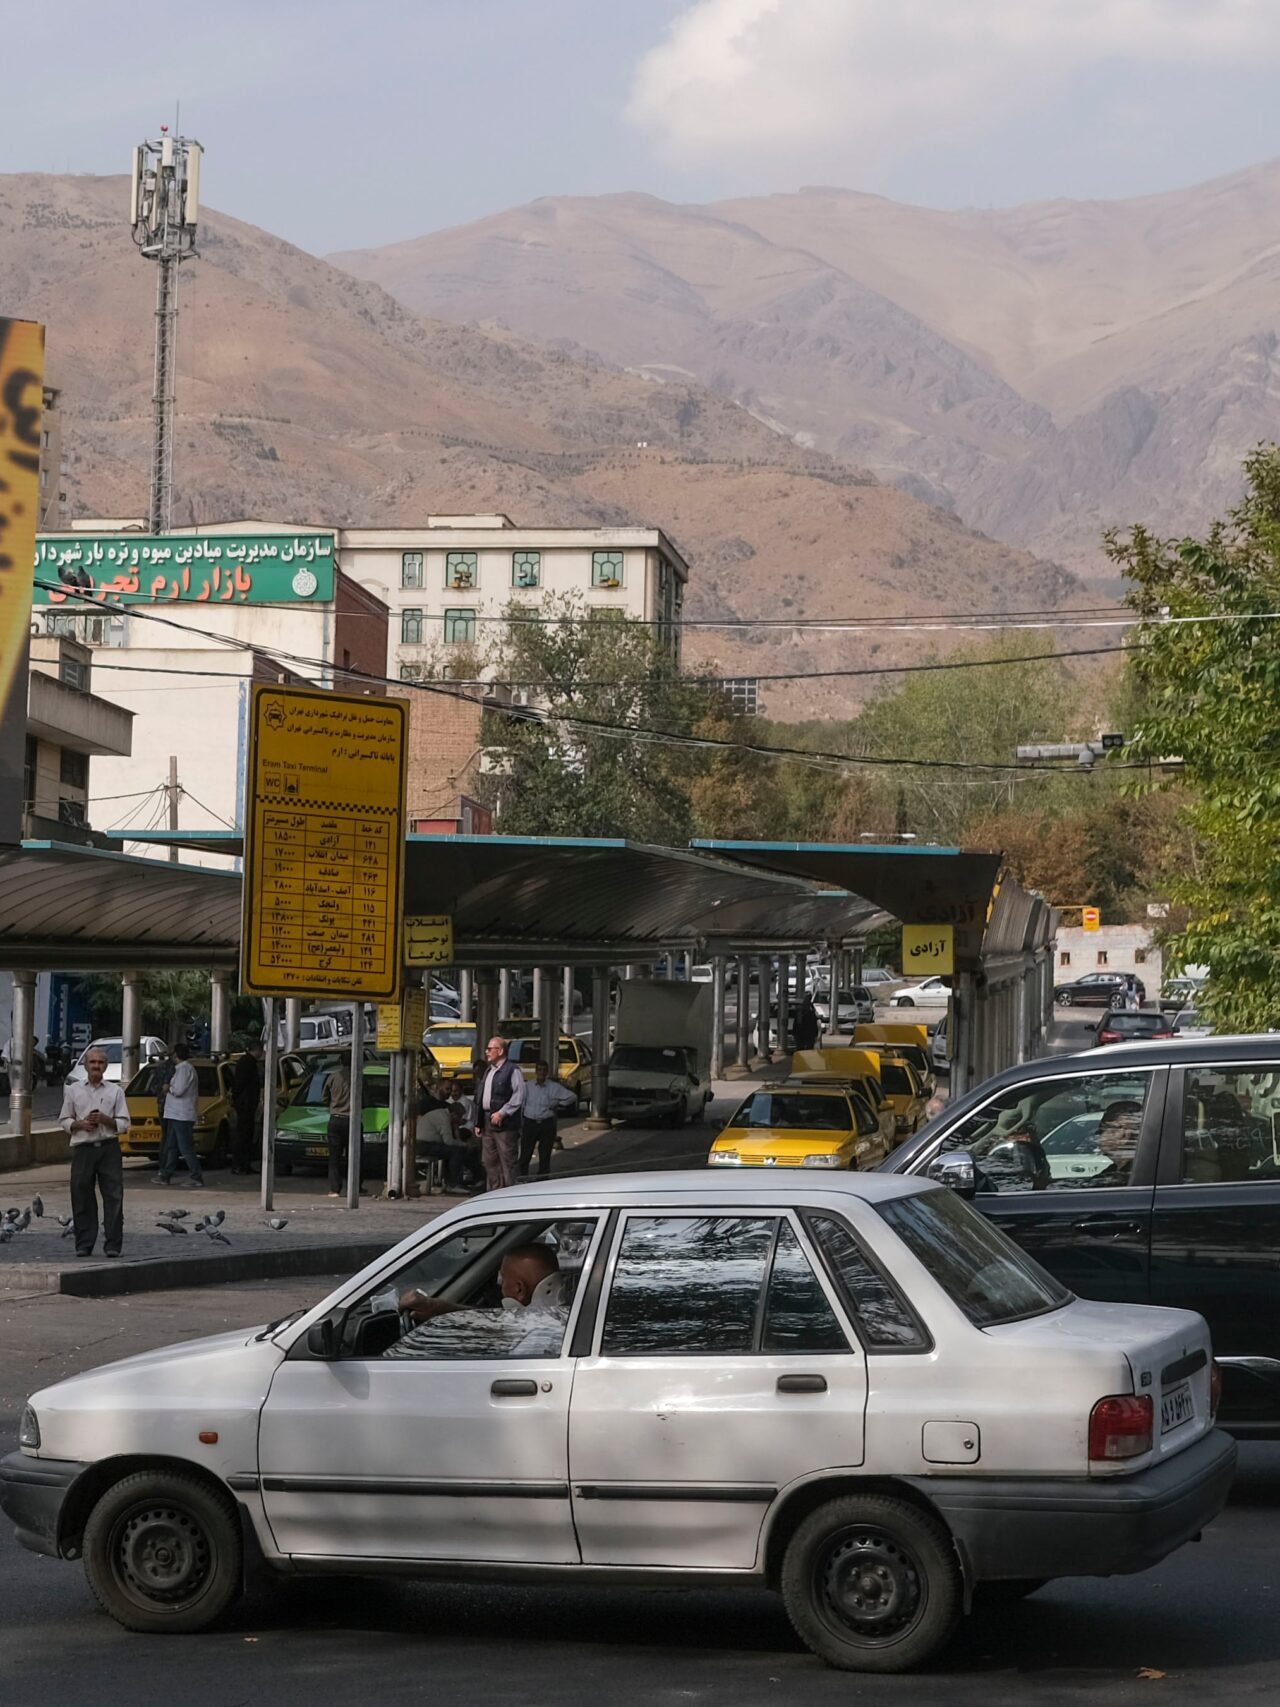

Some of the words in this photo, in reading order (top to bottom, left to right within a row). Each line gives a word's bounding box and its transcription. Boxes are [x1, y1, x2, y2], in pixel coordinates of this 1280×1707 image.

[85, 541, 104, 566] بار
[108, 542, 129, 565] تره
[130, 548, 139, 565] و
[142, 546, 172, 565] میوه
[175, 540, 222, 564] میادین
[226, 542, 278, 563] مدیریت
[281, 538, 331, 562] سازمان
[151, 566, 191, 601] ارم
[197, 566, 252, 600] بازار
[263, 759, 281, 769] Eram
[283, 761, 297, 770] Taxi
[299, 763, 328, 774] Terminal
[266, 778, 281, 788] WC
[910, 940, 946, 957] آزادی
